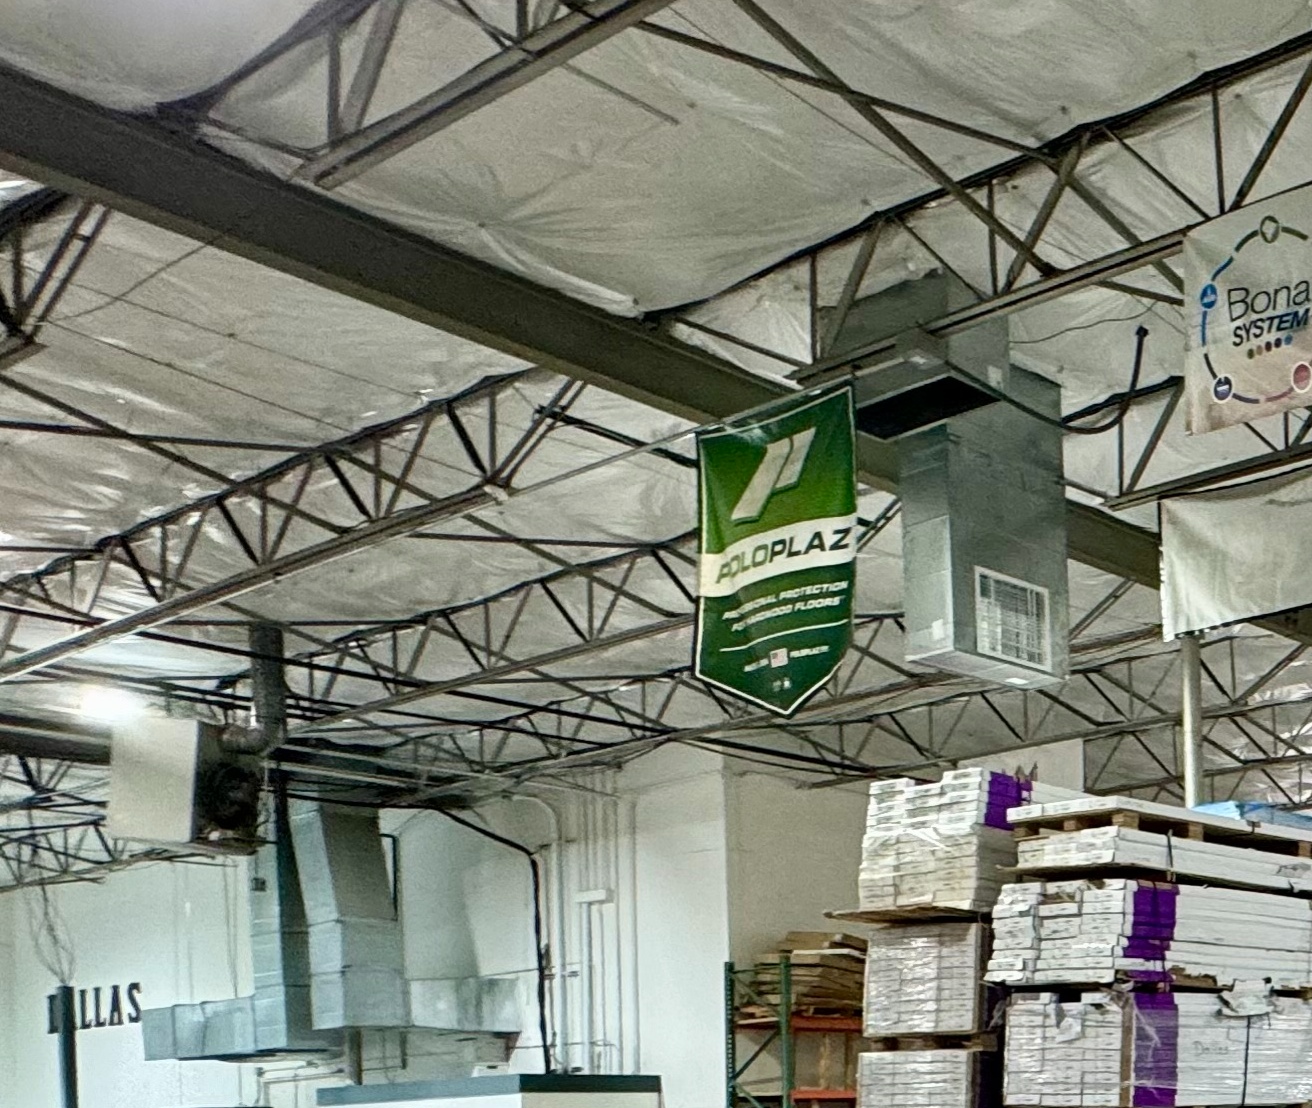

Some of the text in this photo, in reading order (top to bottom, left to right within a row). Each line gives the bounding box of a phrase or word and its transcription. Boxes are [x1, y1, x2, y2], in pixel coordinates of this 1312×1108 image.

[1227, 280, 1312, 322] Bona
[1232, 307, 1311, 347] SYSTEM
[47, 982, 142, 1034] LLAS
